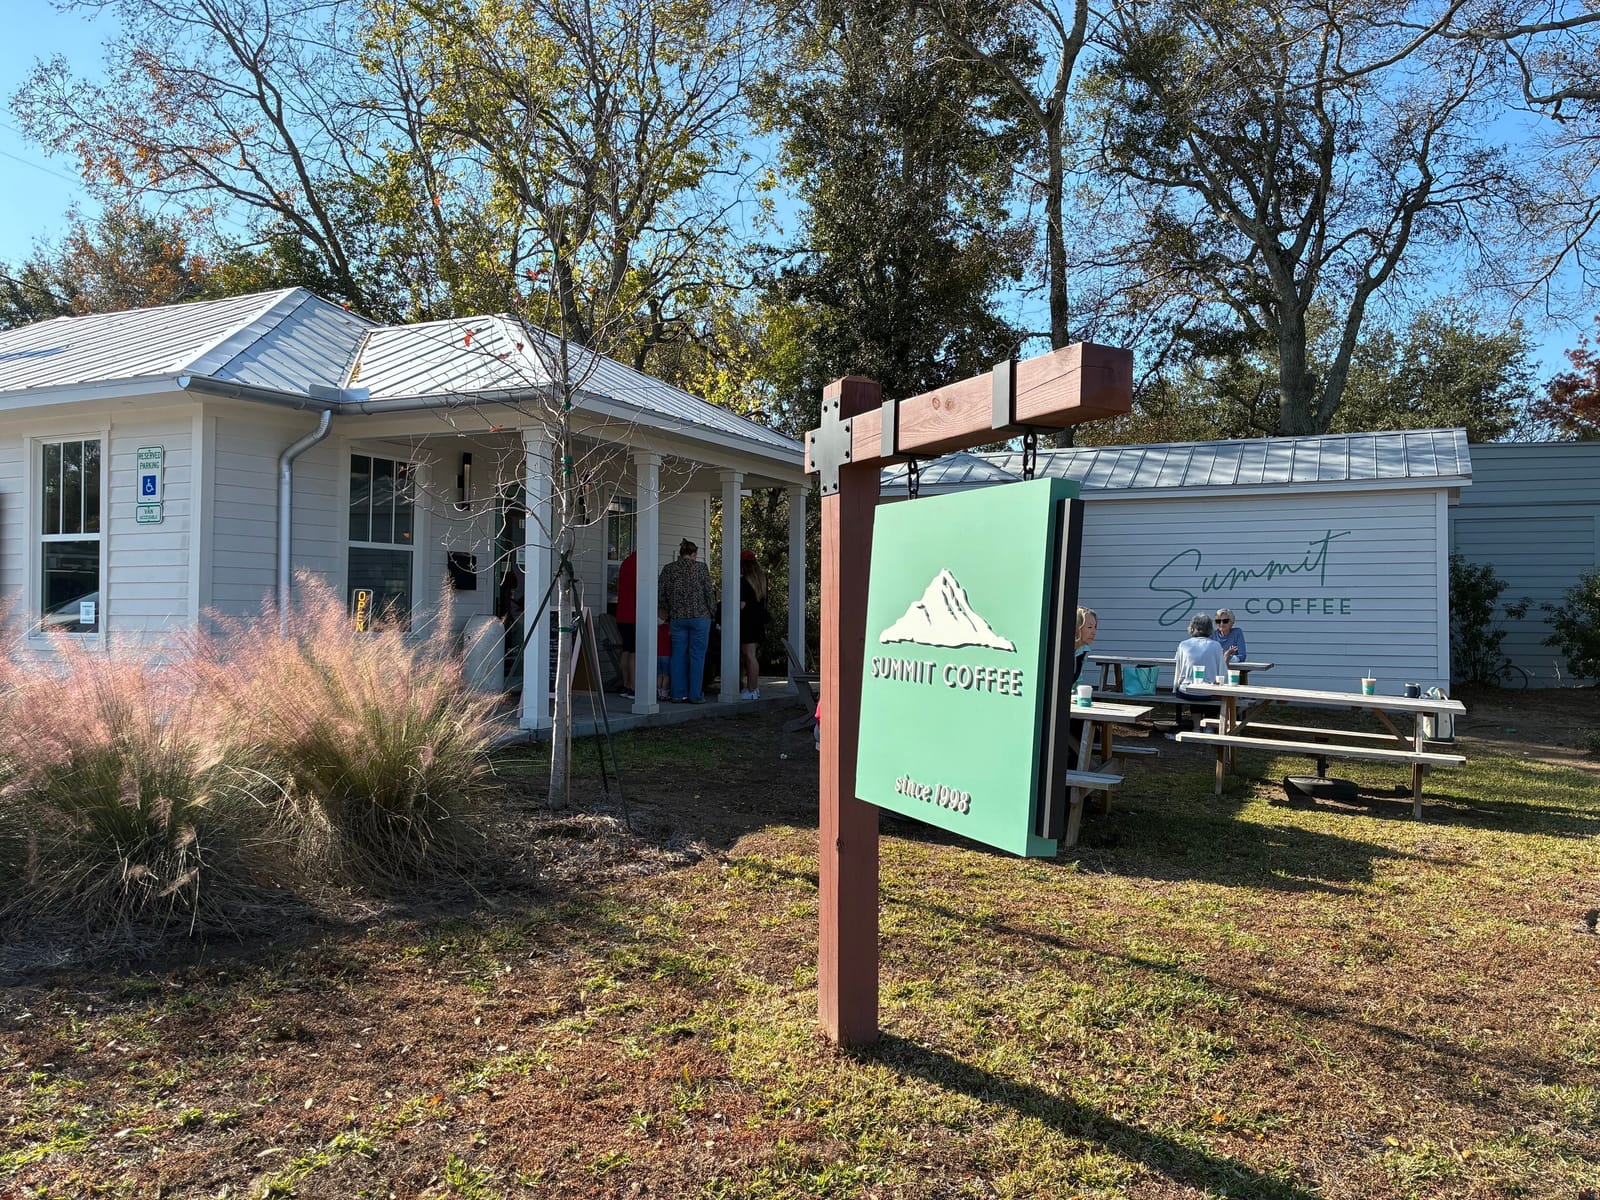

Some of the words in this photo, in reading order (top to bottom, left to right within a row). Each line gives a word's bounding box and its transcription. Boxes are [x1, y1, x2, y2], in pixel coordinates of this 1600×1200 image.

[139, 461, 160, 470] PARKING
[1149, 529, 1351, 626] Summit
[356, 591, 366, 632] OPEN
[1245, 597, 1352, 615] COFFEE
[871, 656, 936, 685] SUMMIT
[943, 663, 1023, 697] COFFEE
[895, 772, 931, 802] since
[934, 783, 971, 815] 1998
